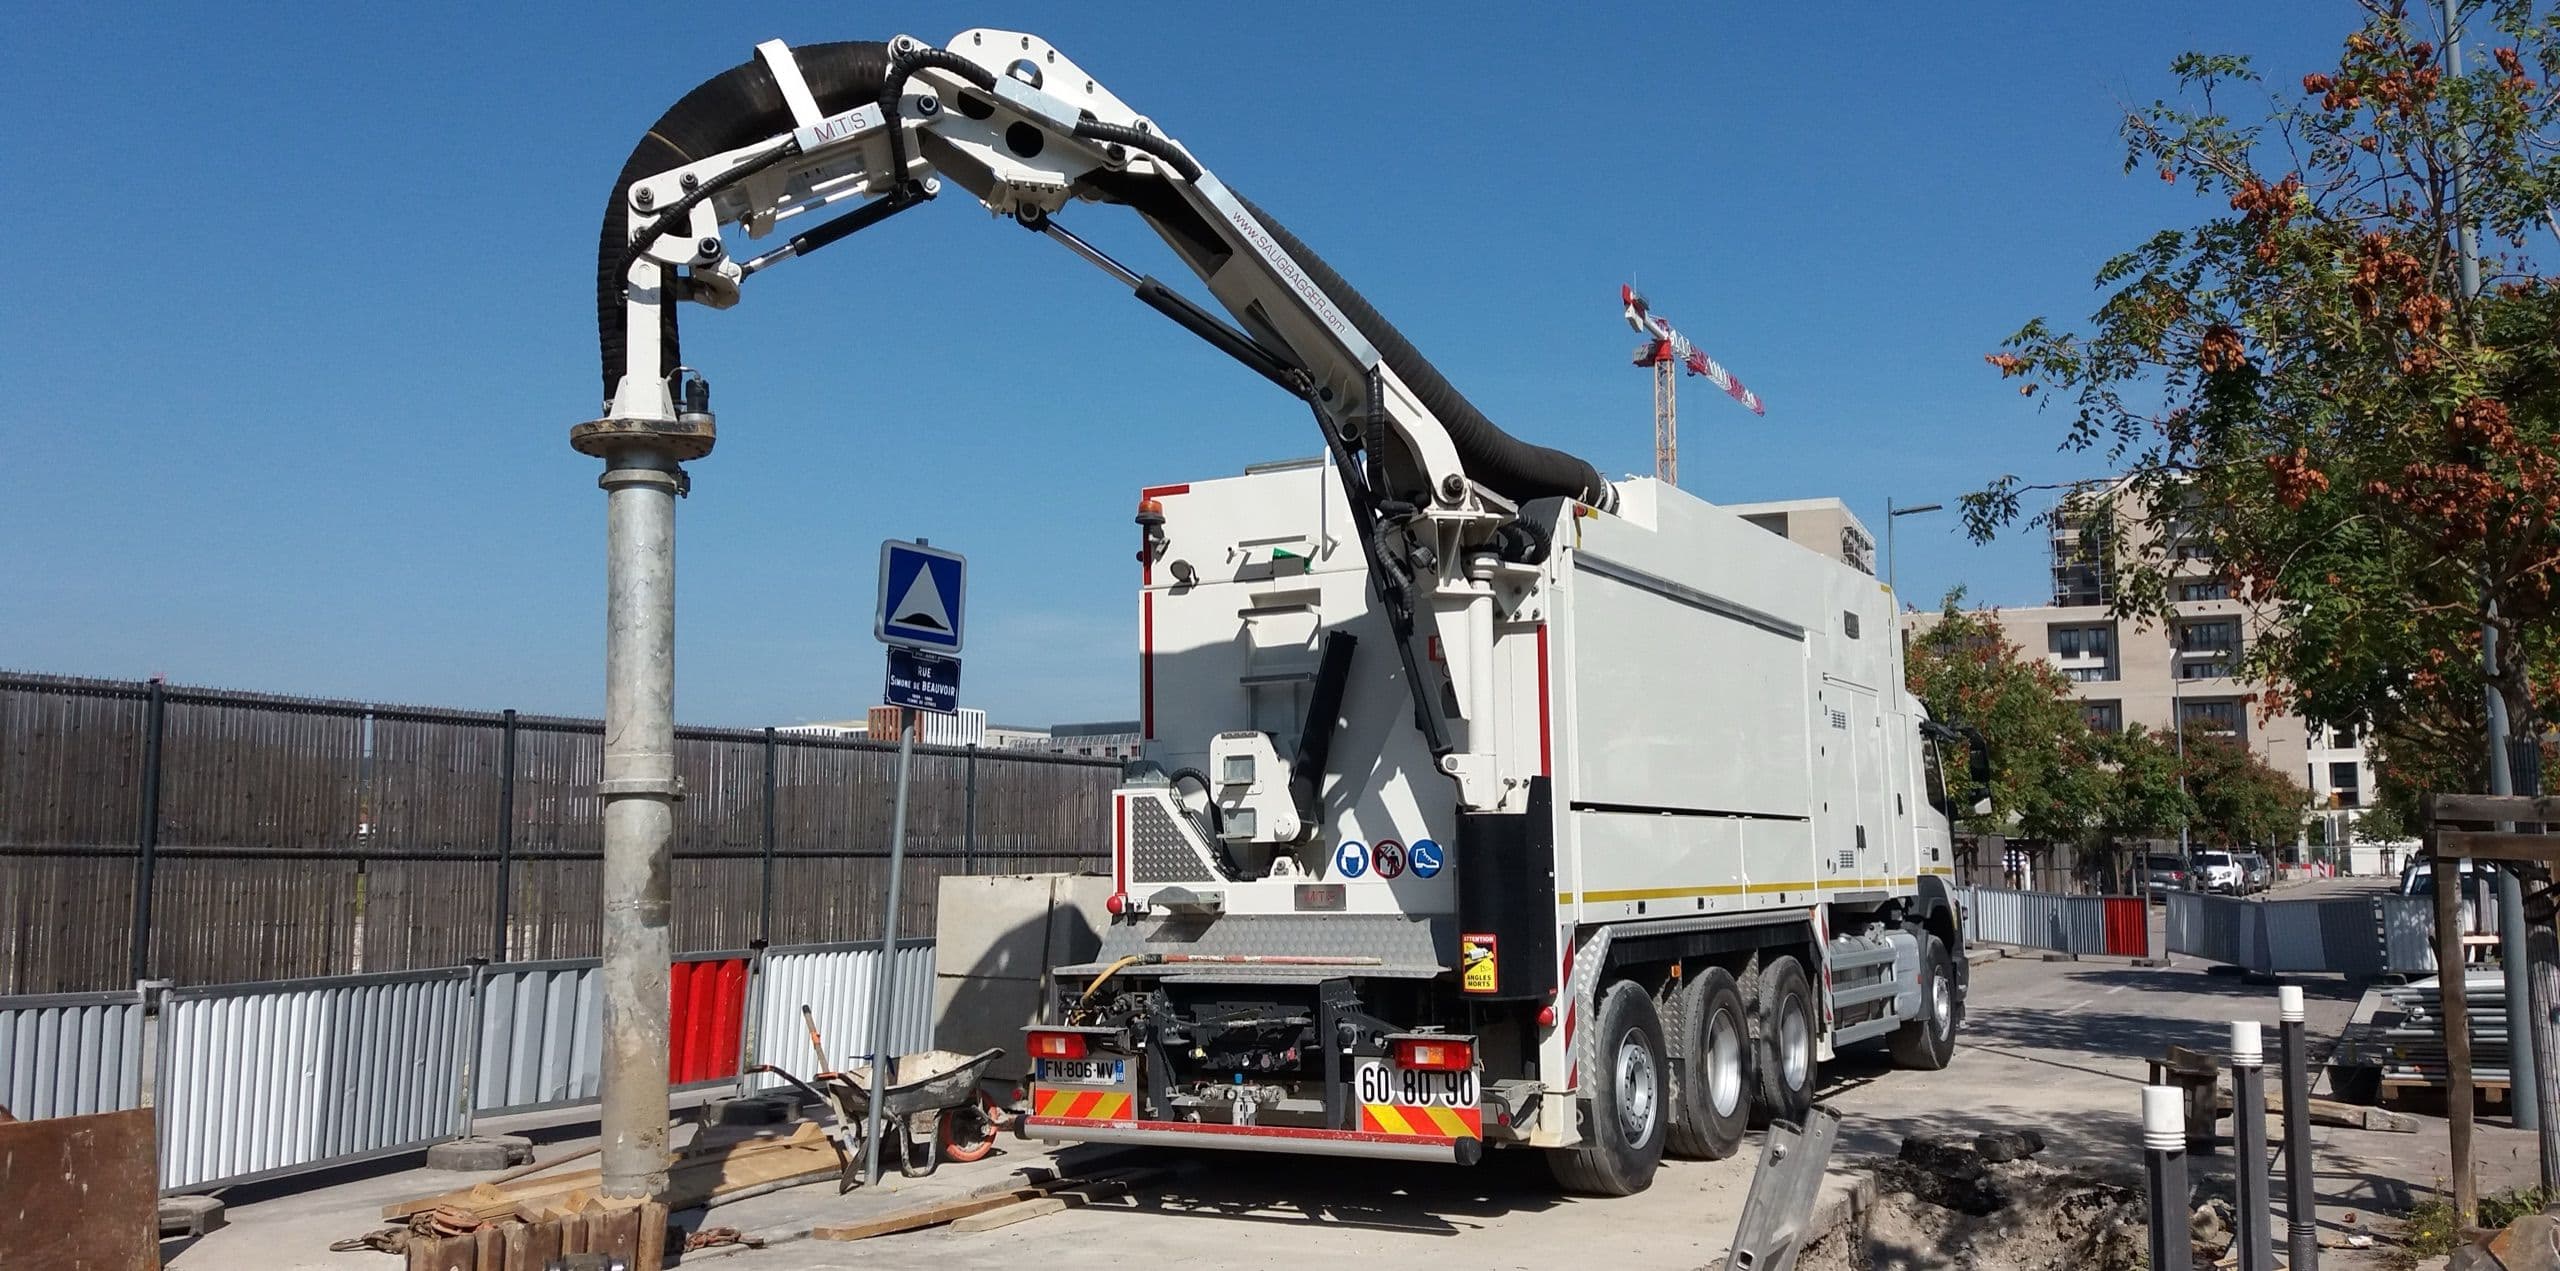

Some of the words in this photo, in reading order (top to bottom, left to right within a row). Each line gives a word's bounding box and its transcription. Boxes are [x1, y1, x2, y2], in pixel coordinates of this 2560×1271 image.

[813, 112, 866, 142] MTS
[1233, 211, 1346, 334] www.SAUGBAGGER.com
[917, 665, 932, 678] RUE
[921, 680, 956, 697] BEAUVOIR
[1362, 1066, 1389, 1103] 60
[1403, 1069, 1431, 1105] 80
[1445, 1070, 1473, 1106] 90
